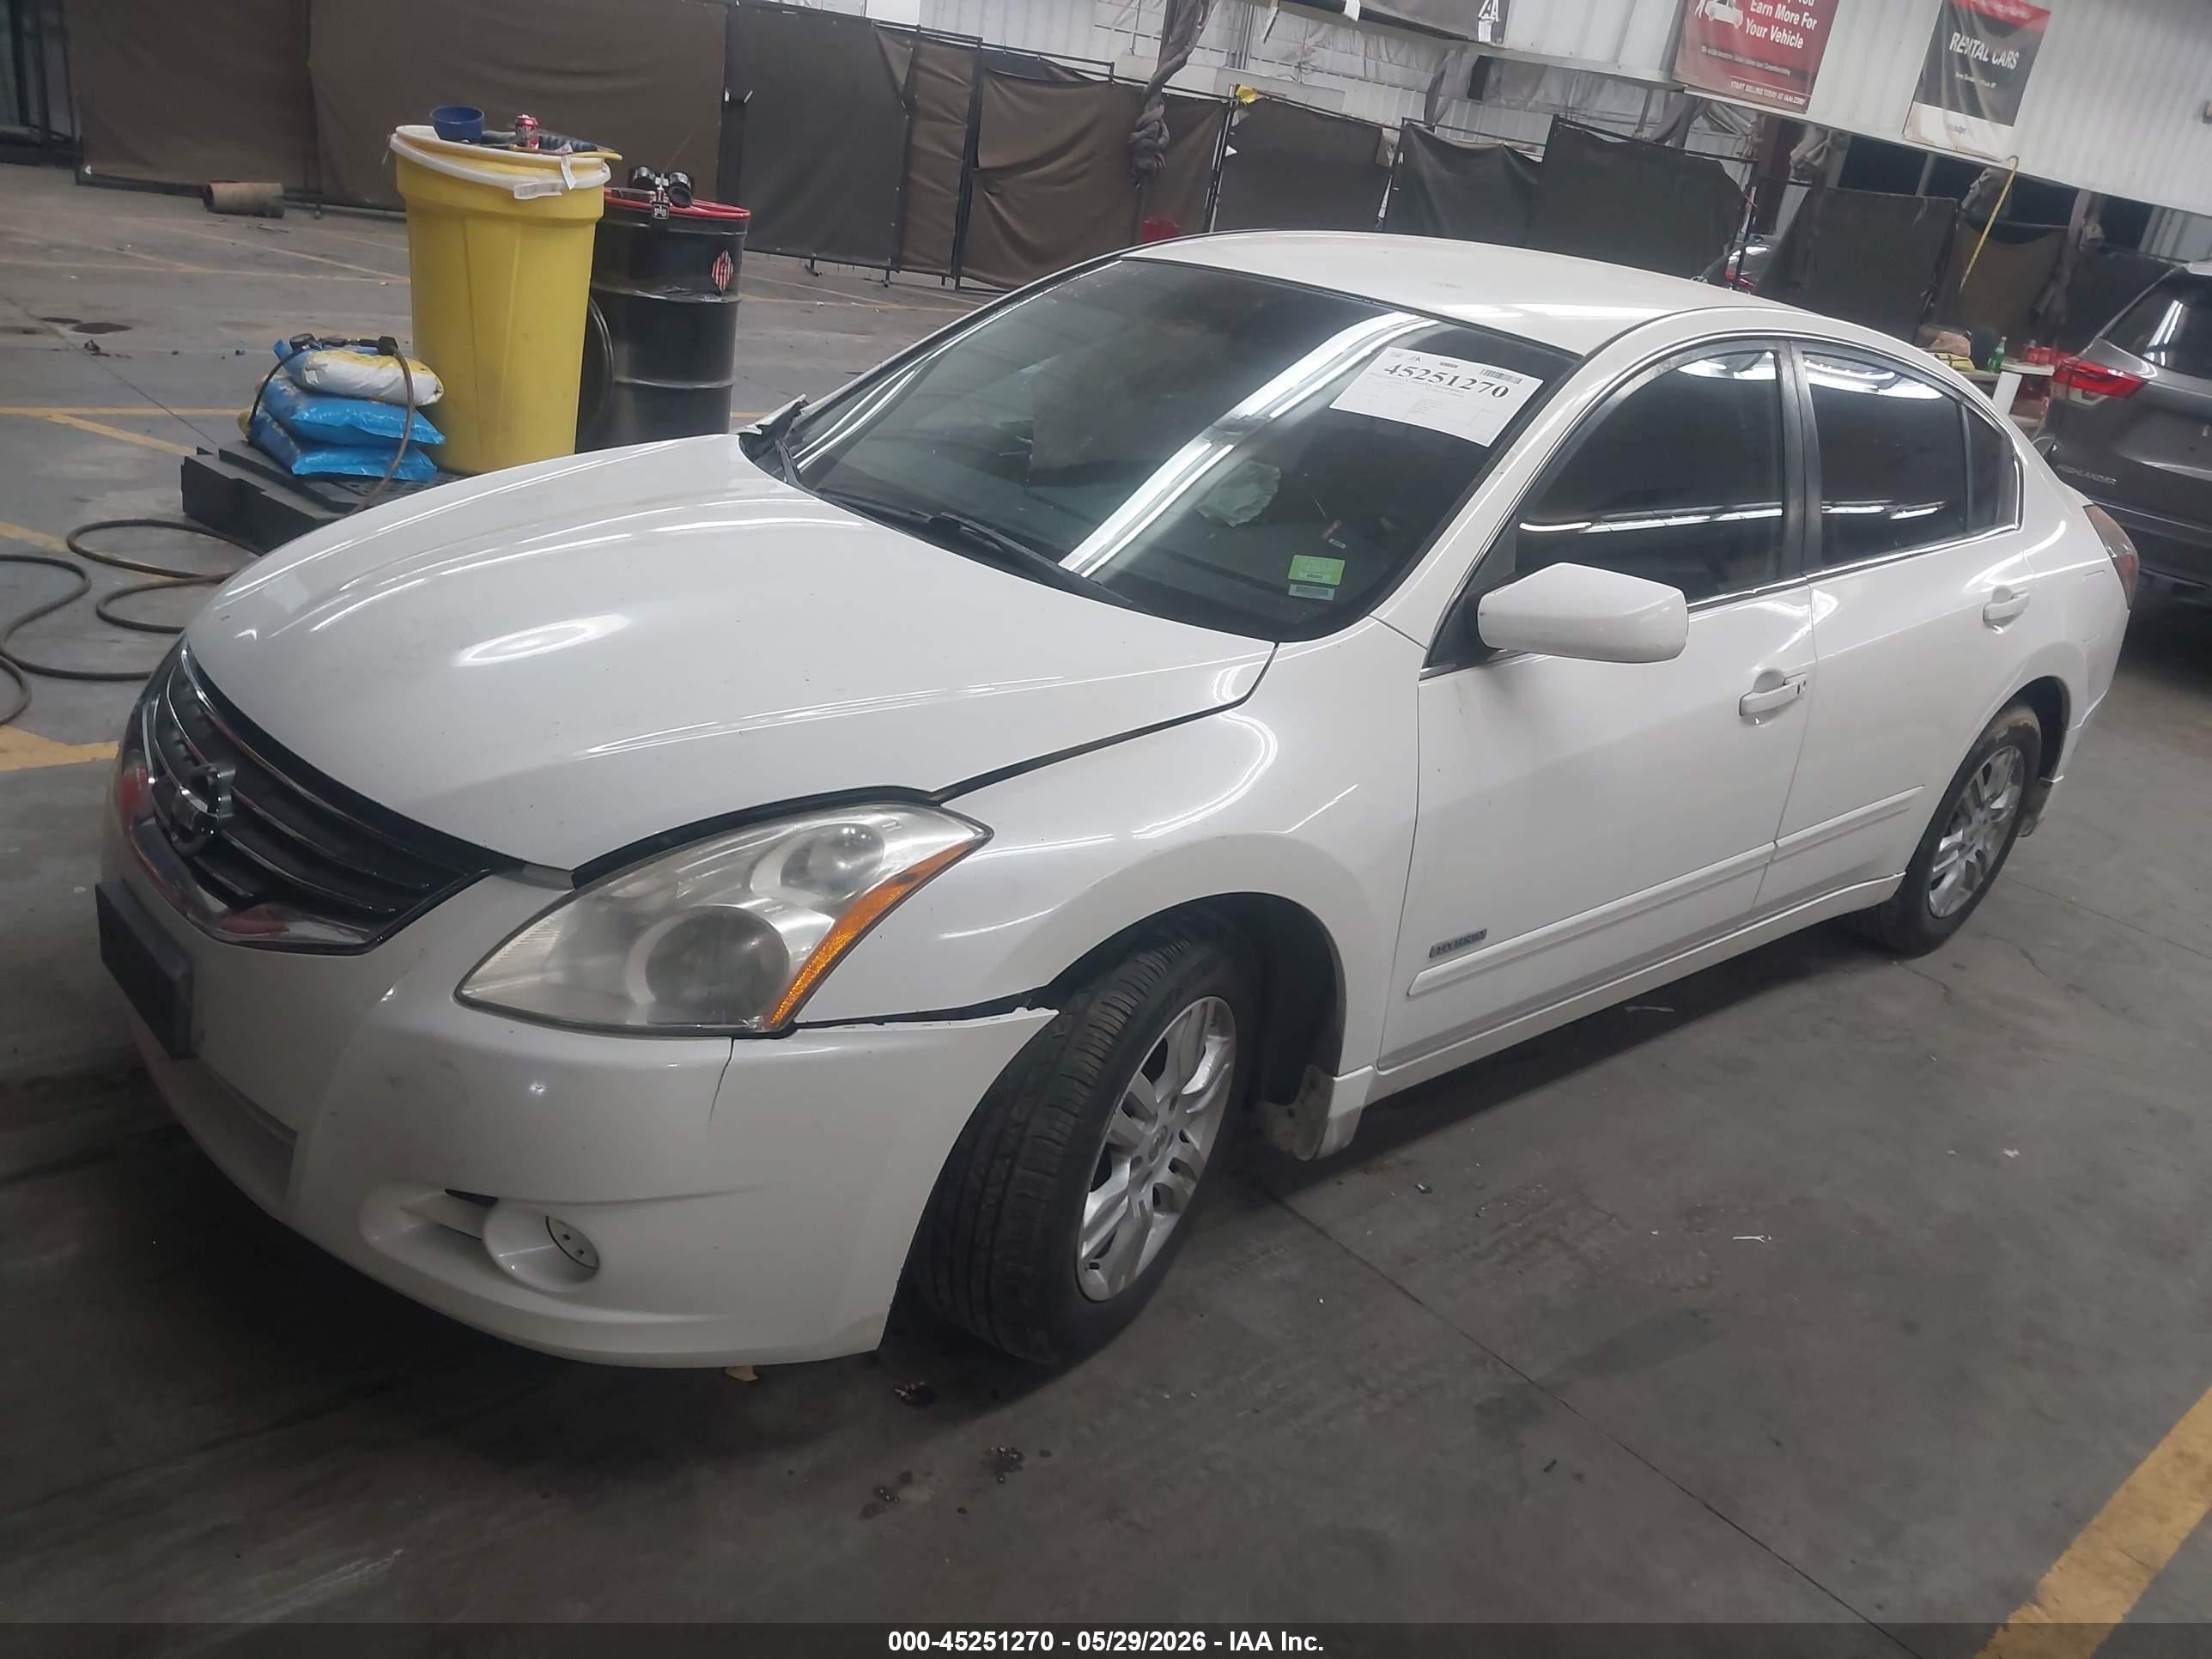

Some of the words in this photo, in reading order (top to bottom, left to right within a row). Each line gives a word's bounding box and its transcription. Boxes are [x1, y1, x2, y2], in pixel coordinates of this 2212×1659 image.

[1750, 0, 1773, 17] Earn
[1774, 3, 1800, 25] More
[1801, 11, 1817, 30] For
[1745, 17, 1768, 39] Your
[1770, 24, 1804, 49] Vehicle
[1949, 32, 1989, 62] RENTAL
[1991, 49, 2020, 70] CARS
[1384, 363, 1510, 398] 45251270
